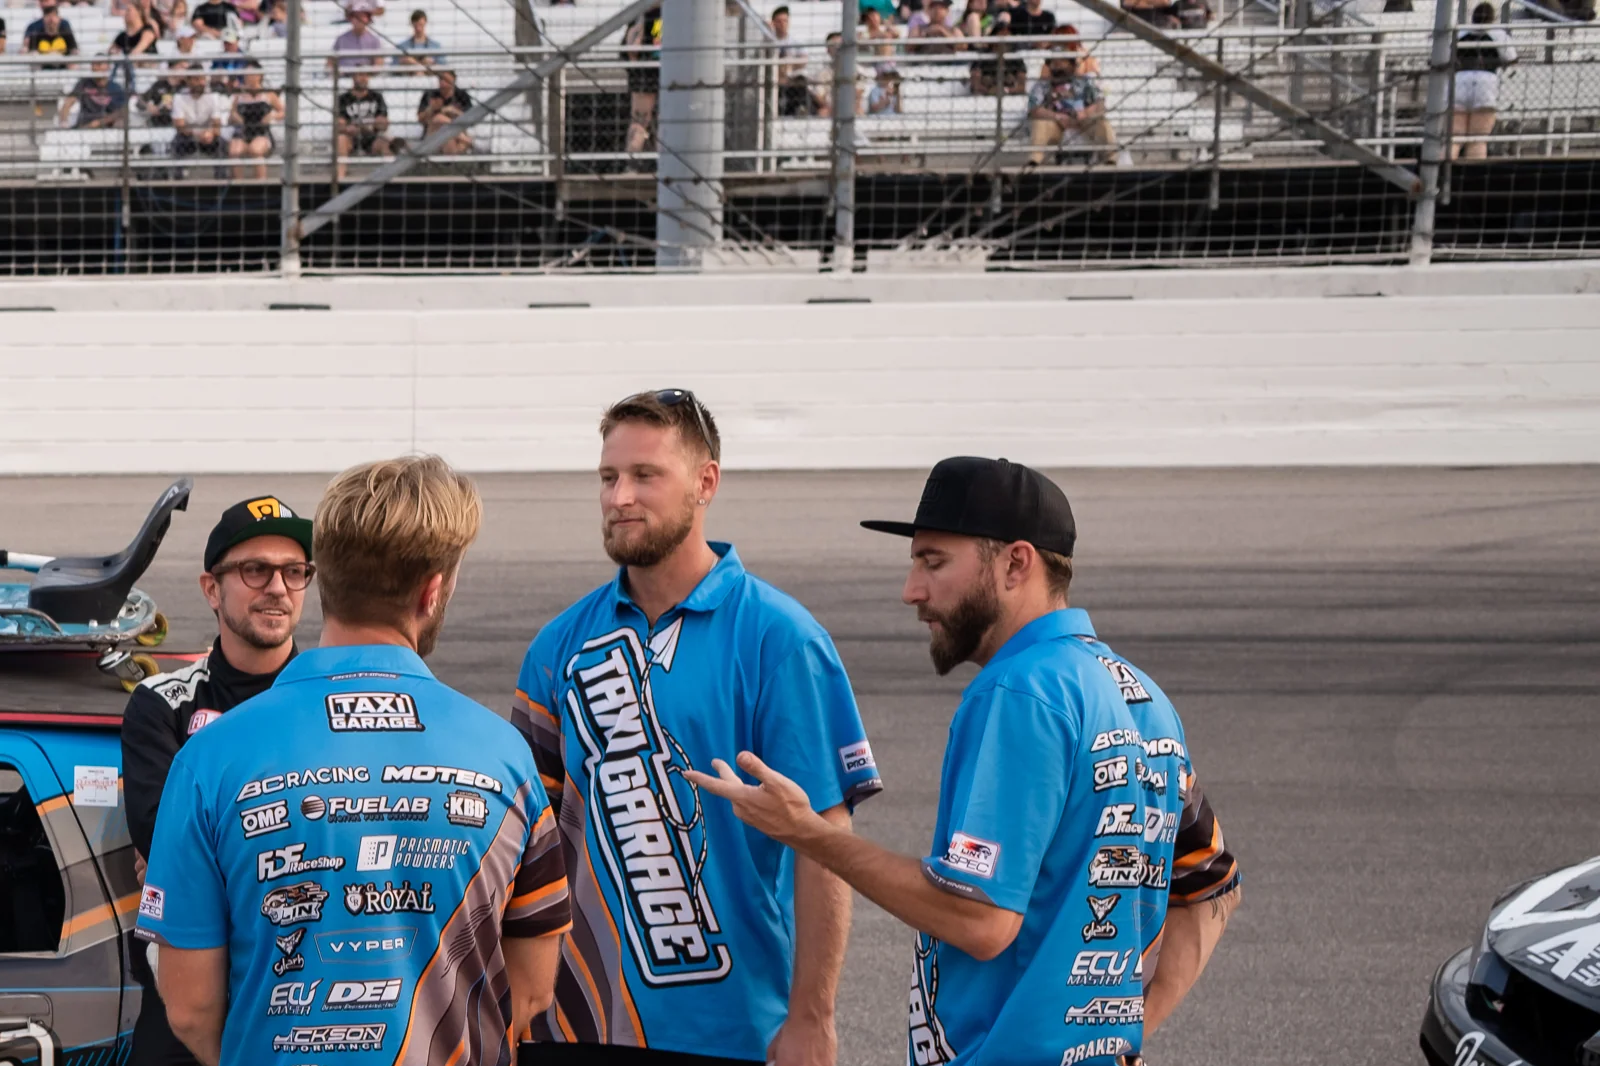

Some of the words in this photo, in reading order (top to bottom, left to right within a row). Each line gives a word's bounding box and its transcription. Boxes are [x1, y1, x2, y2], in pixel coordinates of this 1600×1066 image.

[334, 697, 406, 714] TAXI
[578, 647, 649, 754] TAXI
[332, 717, 417, 730] GARAGE
[243, 806, 288, 832] OMP
[329, 796, 430, 815] FUELAB
[450, 796, 485, 819] KBD
[400, 837, 471, 855] PRISMATIC
[394, 853, 455, 870] POWDERS
[600, 755, 708, 962] GARAGE
[364, 889, 435, 913] ROYAL
[329, 937, 404, 953] VYPER
[1071, 947, 1135, 976] ECU
